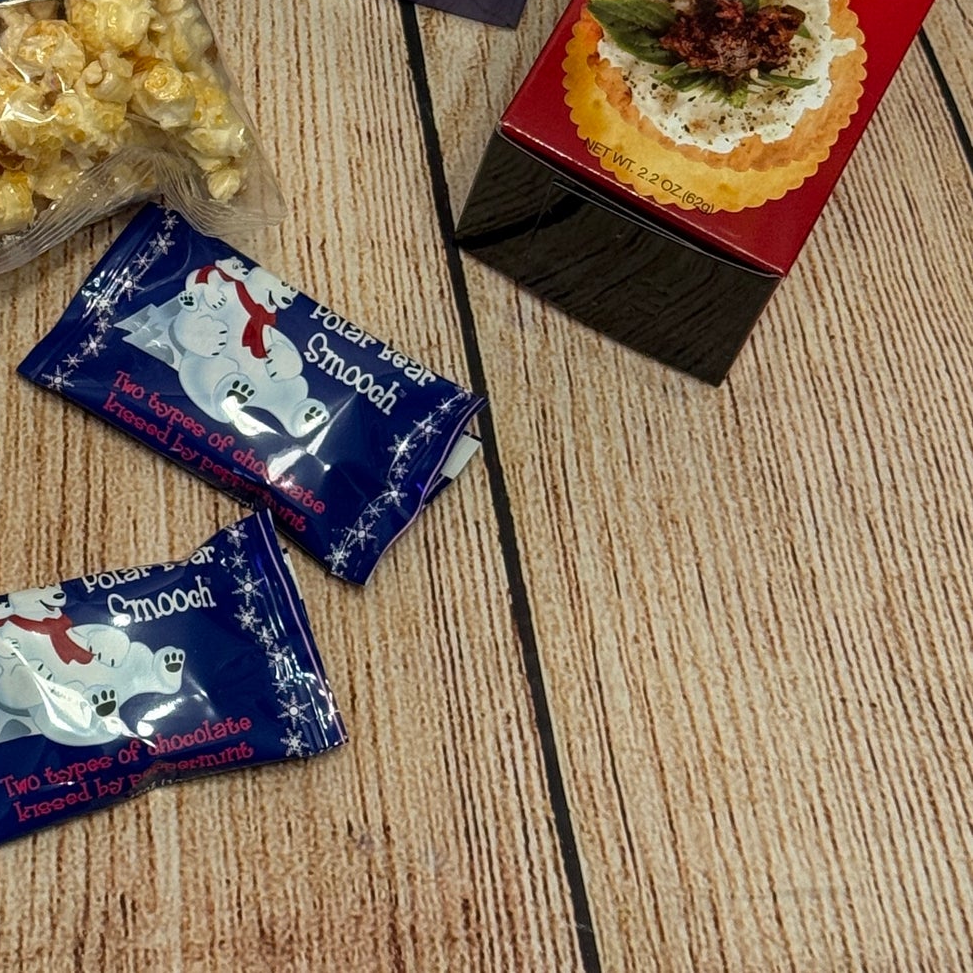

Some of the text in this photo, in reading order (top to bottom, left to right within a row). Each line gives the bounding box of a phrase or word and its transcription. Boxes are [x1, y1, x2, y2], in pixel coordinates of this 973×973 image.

[584, 137, 611, 158] NET
[612, 152, 636, 173] WT.
[637, 167, 660, 185] 2.2
[309, 304, 377, 348] Polar
[303, 331, 401, 416] Smooch
[102, 392, 172, 446] kissed
[171, 438, 200, 463] by
[113, 370, 145, 400] Two
[148, 392, 206, 437] types
[207, 429, 236, 453] of
[107, 576, 217, 627] Smooch
[0, 717, 252, 798] Two types of chocolate
[13, 783, 93, 823] kissed
[97, 776, 125, 798] by
